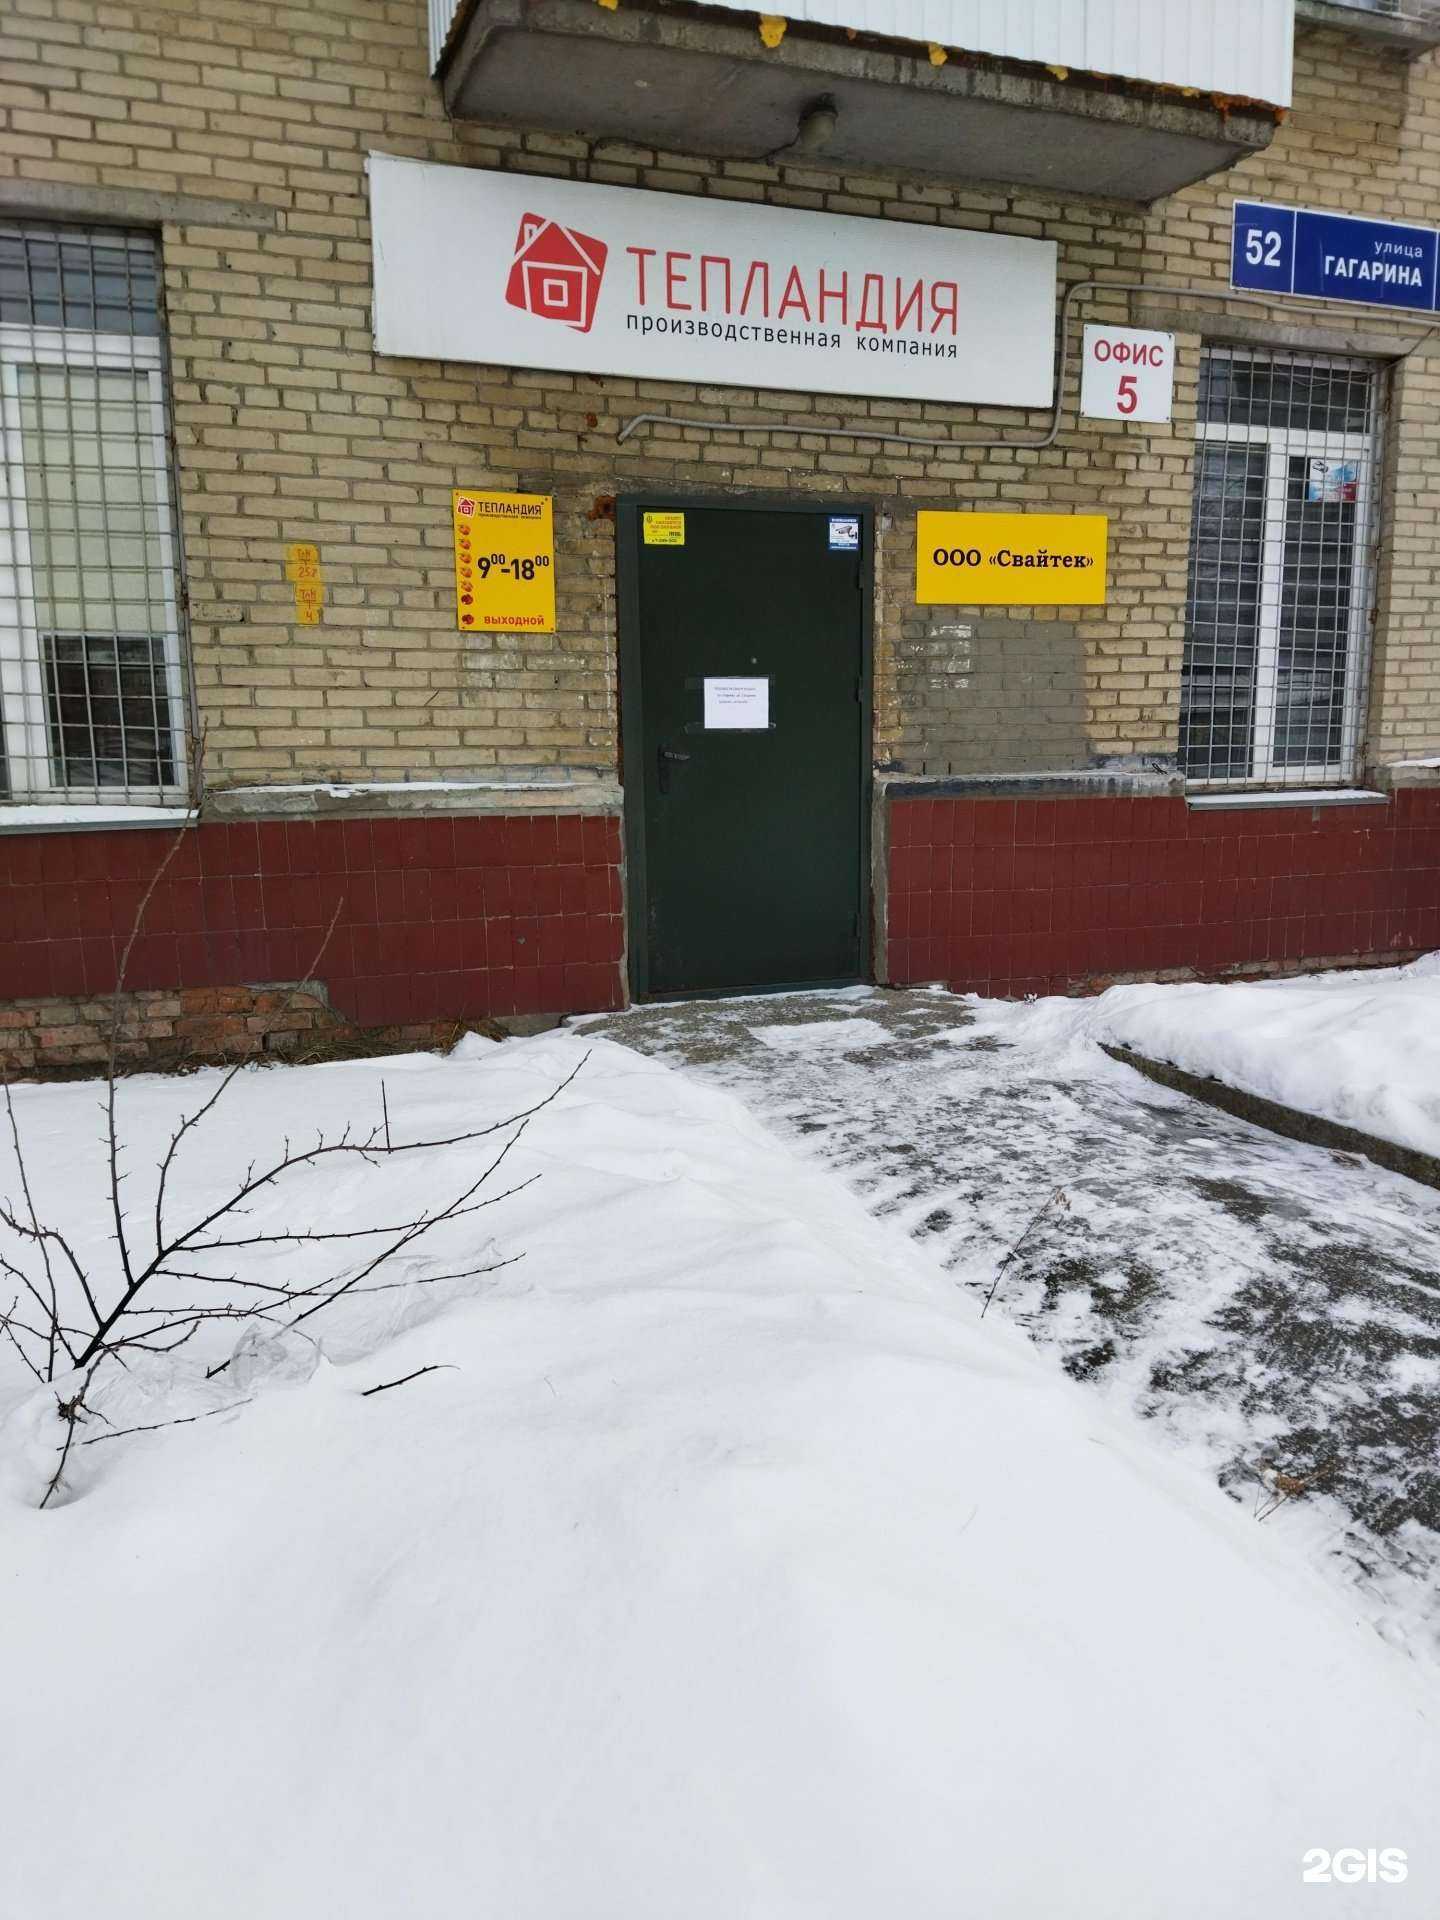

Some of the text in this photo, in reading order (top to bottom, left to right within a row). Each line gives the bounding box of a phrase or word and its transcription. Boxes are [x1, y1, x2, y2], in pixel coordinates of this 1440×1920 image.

[1245, 229, 1282, 267] 52
[1374, 239, 1424, 259] улица
[1324, 255, 1423, 287] ГАГАРИНА
[626, 246, 959, 335] ТЕПЛАНДИЯ
[626, 312, 959, 358] производственная компания
[1094, 340, 1164, 367] ОФИС
[1116, 376, 1138, 414] 5
[478, 501, 542, 516] ТЕПЛАНДИЯ
[933, 548, 1094, 568] ООО «Свайтек»
